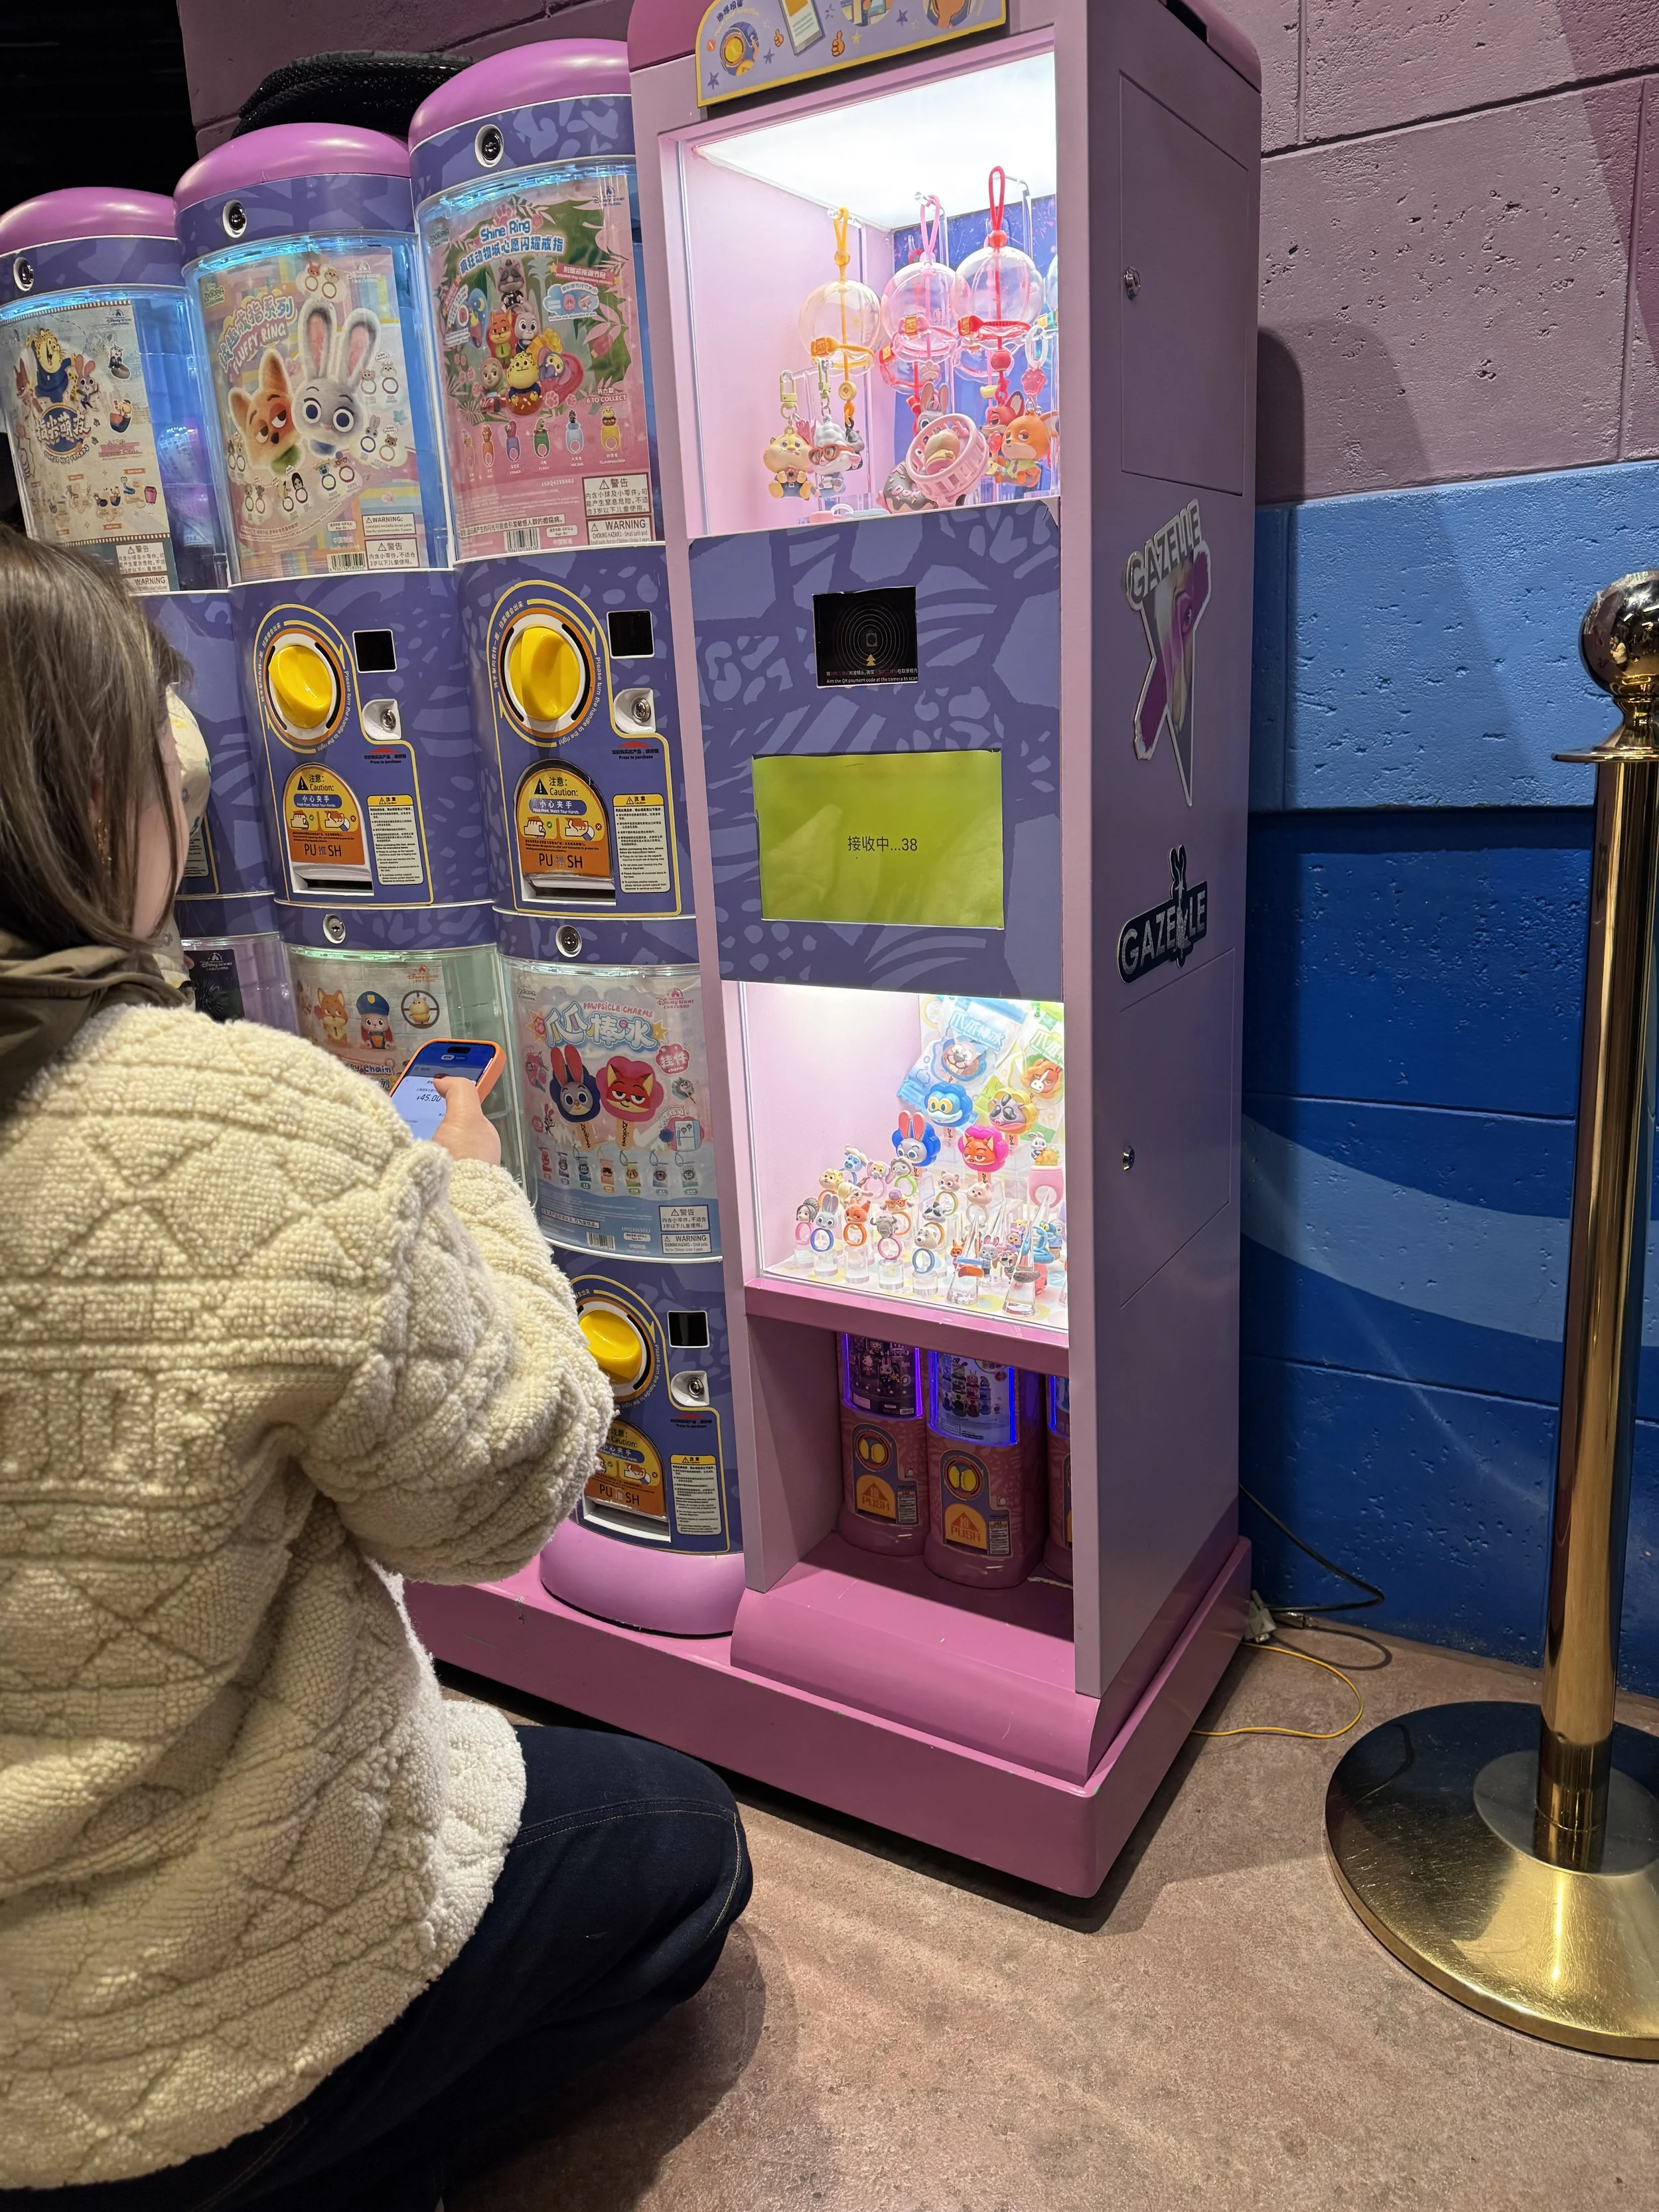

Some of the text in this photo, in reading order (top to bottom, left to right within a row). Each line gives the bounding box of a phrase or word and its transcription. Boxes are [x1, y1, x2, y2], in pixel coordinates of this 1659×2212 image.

[480, 220, 530, 242] Shine Ring
[459, 236, 563, 275] 疯狂动物城心愿闪耀戒指
[233, 334, 258, 375] FLUFFY
[611, 478, 628, 488] 警告
[387, 542, 402, 551] 警告
[1131, 506, 1200, 604] GAZELLE
[583, 706, 597, 727] handle
[558, 736, 571, 746] right
[549, 788, 579, 796] Caution:
[305, 844, 317, 856] PU
[328, 845, 342, 857] SH
[847, 836, 917, 852] 接收中...38
[539, 853, 553, 867] PU
[567, 855, 583, 869] SH
[622, 1005, 654, 1018] CHARMS
[660, 1052, 687, 1069] 挂件
[360, 1065, 392, 1075] Chain
[416, 1094, 441, 1102] ¥45.00
[612, 1436, 637, 1448] Caution:
[599, 1484, 612, 1497] PU
[626, 1493, 640, 1506] SH
[862, 1496, 890, 1511] PUSH
[951, 1526, 981, 1542] PUSH
